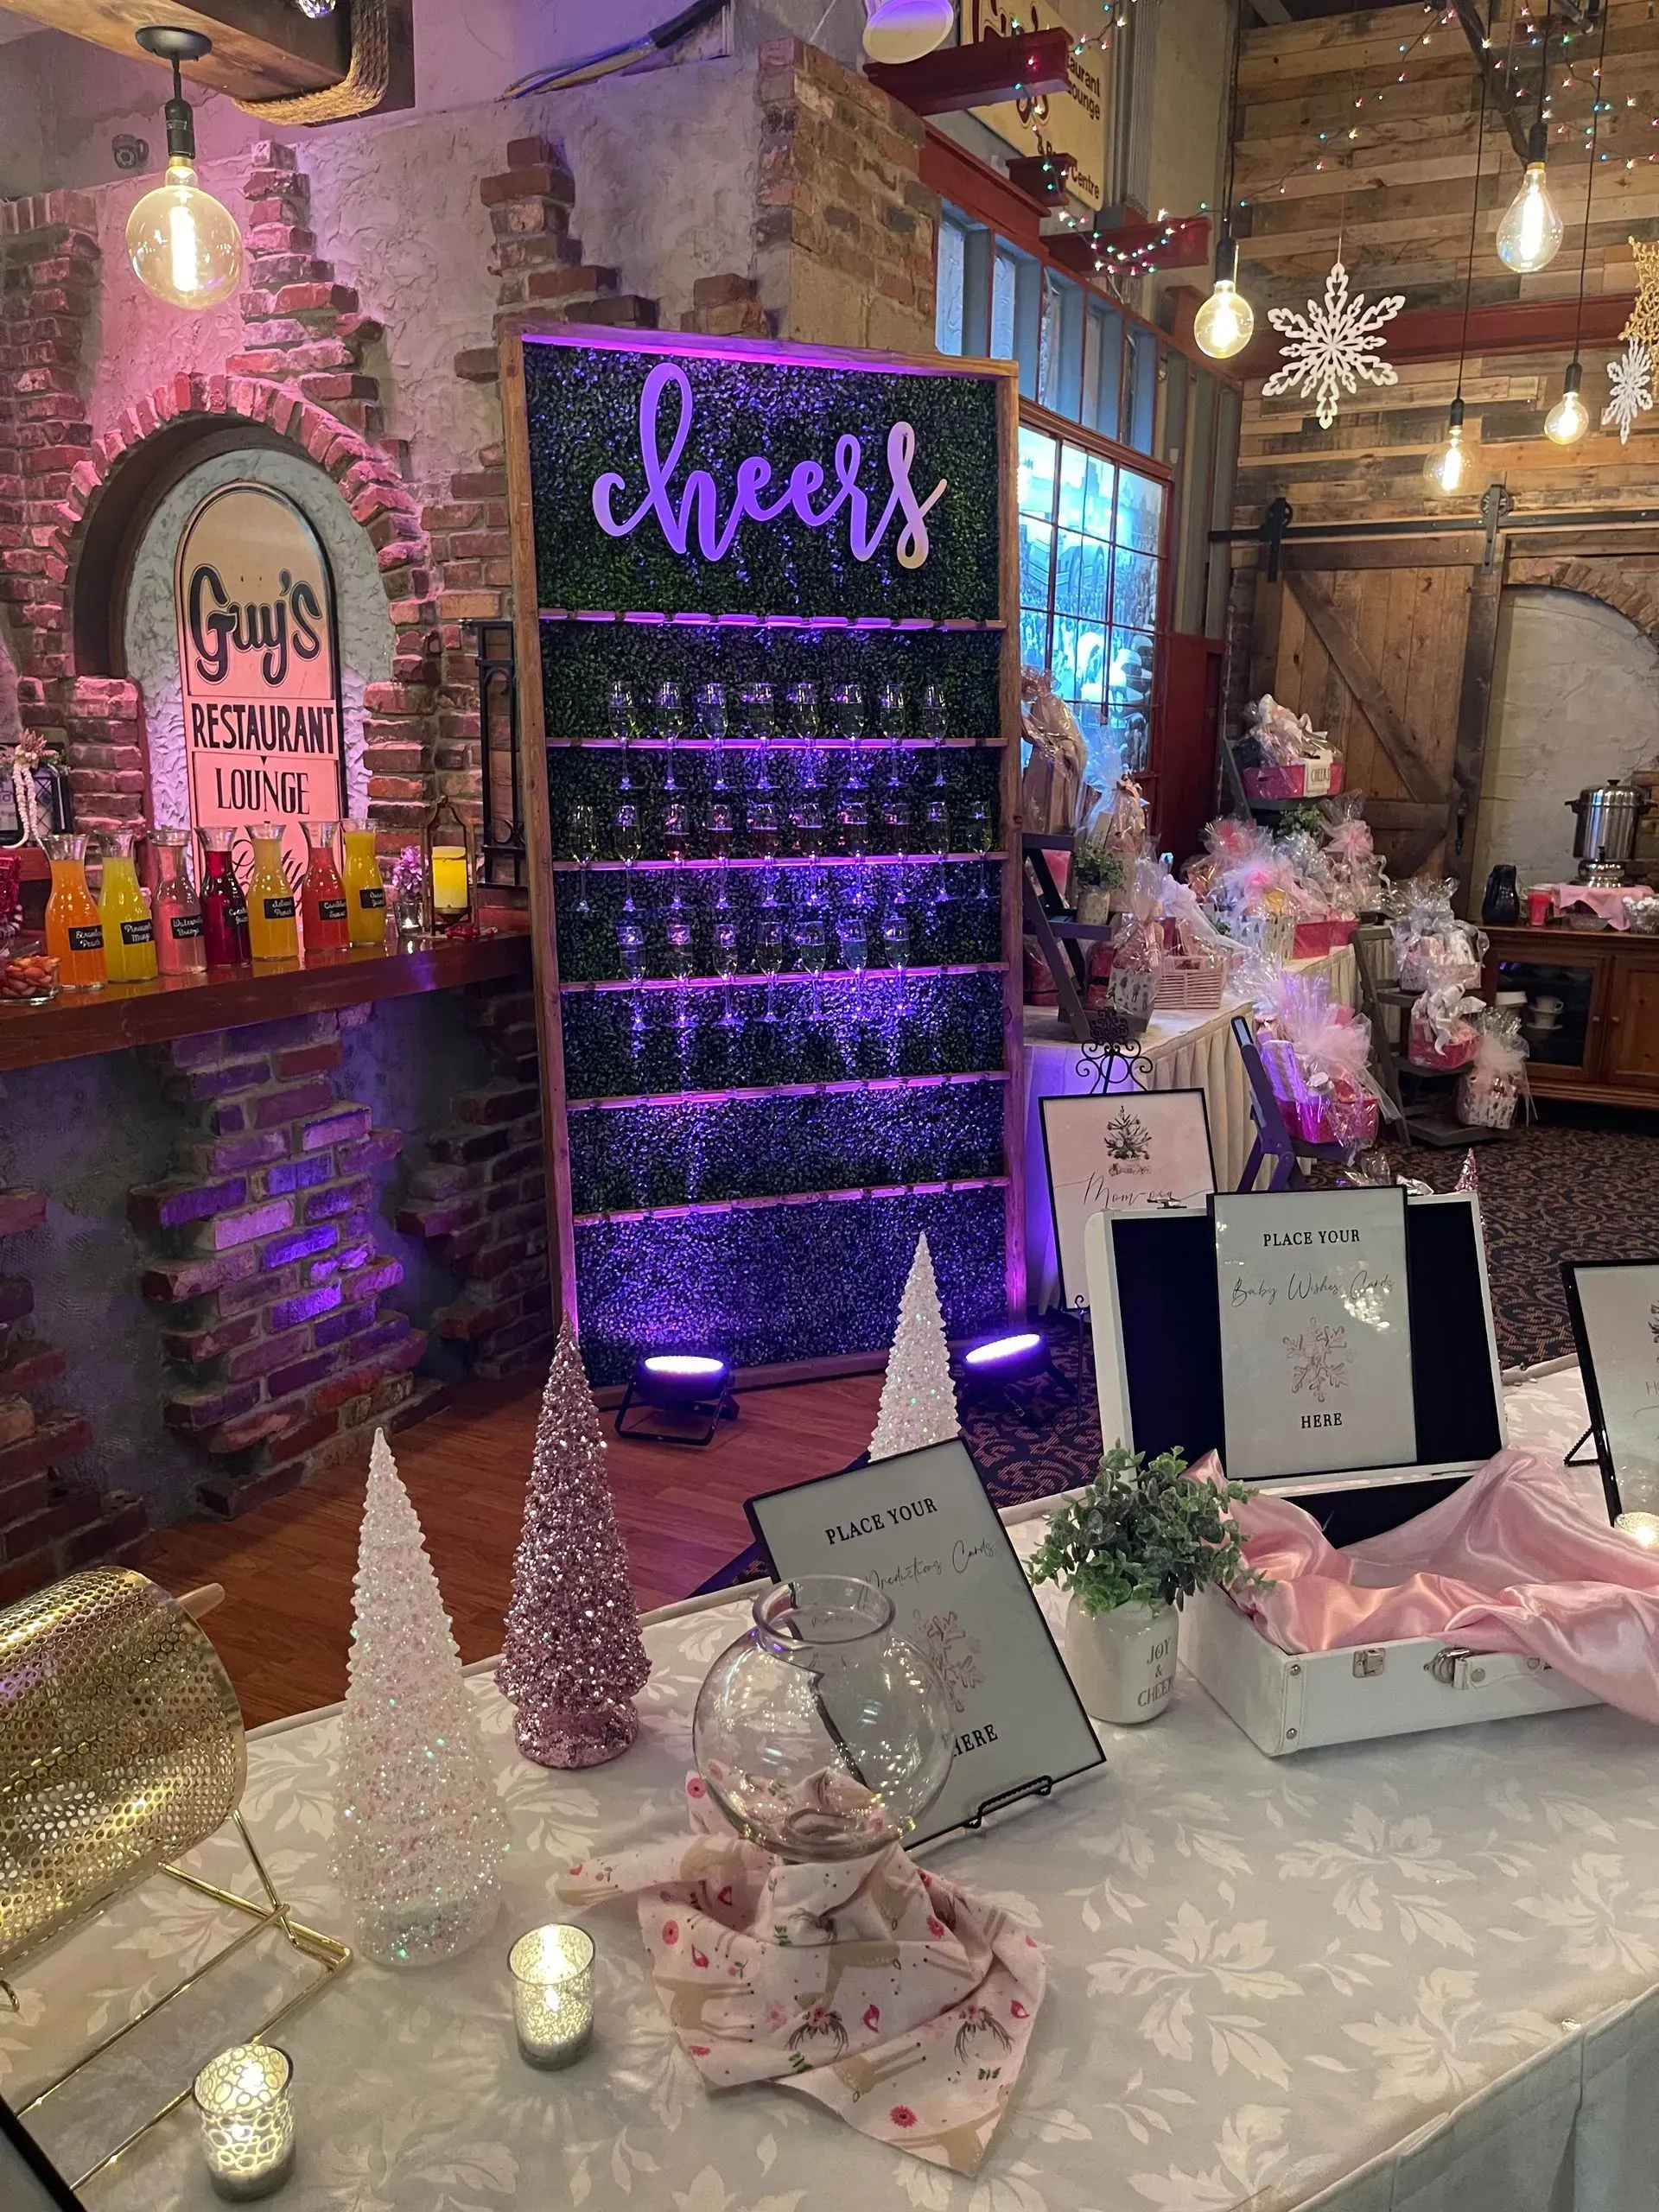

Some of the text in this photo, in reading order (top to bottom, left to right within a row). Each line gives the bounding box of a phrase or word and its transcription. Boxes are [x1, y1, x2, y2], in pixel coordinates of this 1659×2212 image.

[1070, 90, 1101, 120] ounge
[592, 363, 947, 569] cheers
[189, 564, 323, 688] Guy's
[192, 702, 334, 754] RESTAURANT
[216, 768, 309, 816] LOUNGE
[1263, 1229, 1361, 1247] PLACE YOUR
[1231, 1276, 1278, 1307] Baby
[1300, 1413, 1343, 1428] HERE
[824, 1497, 938, 1545] PLACE YOUR
[952, 1537, 995, 1573] Cards
[1147, 1637, 1172, 1664] JOY
[1154, 1664, 1163, 1678] &
